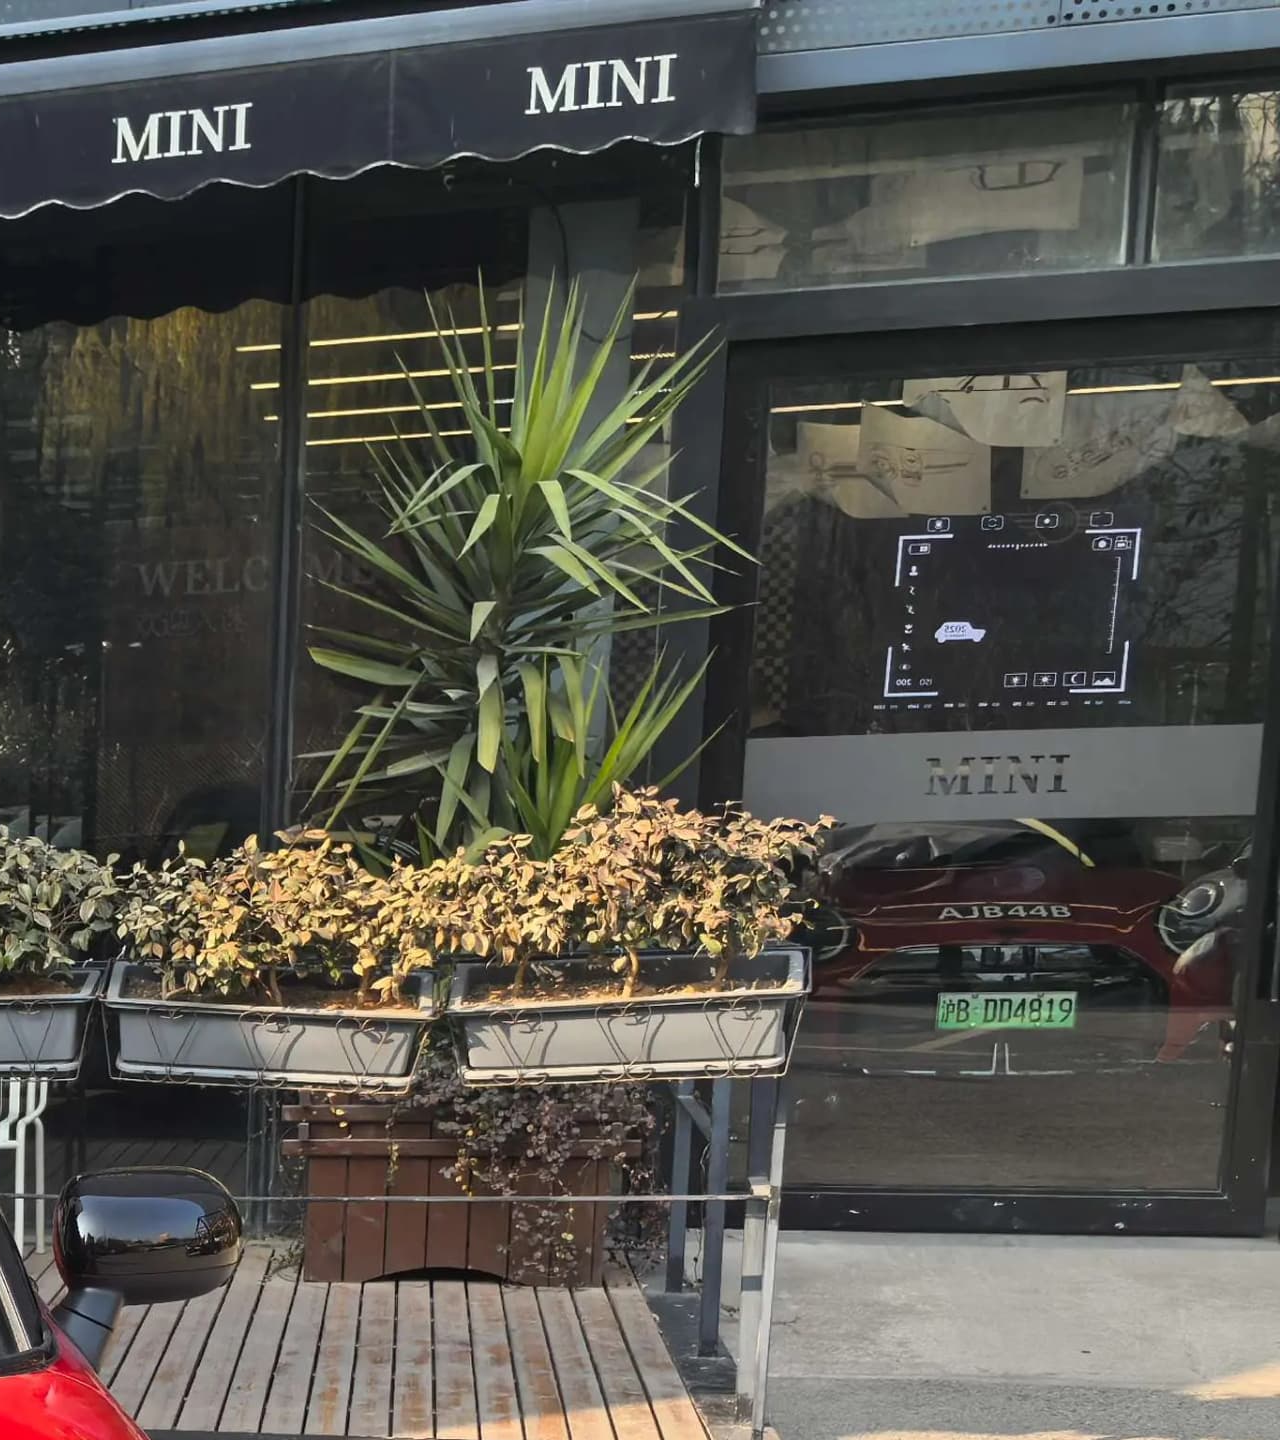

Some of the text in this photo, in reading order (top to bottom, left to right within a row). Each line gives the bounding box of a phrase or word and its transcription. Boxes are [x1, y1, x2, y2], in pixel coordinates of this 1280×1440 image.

[525, 53, 678, 115] MINI
[111, 102, 253, 164] MINI
[137, 550, 376, 598] WELCME
[924, 754, 1072, 796] MINI
